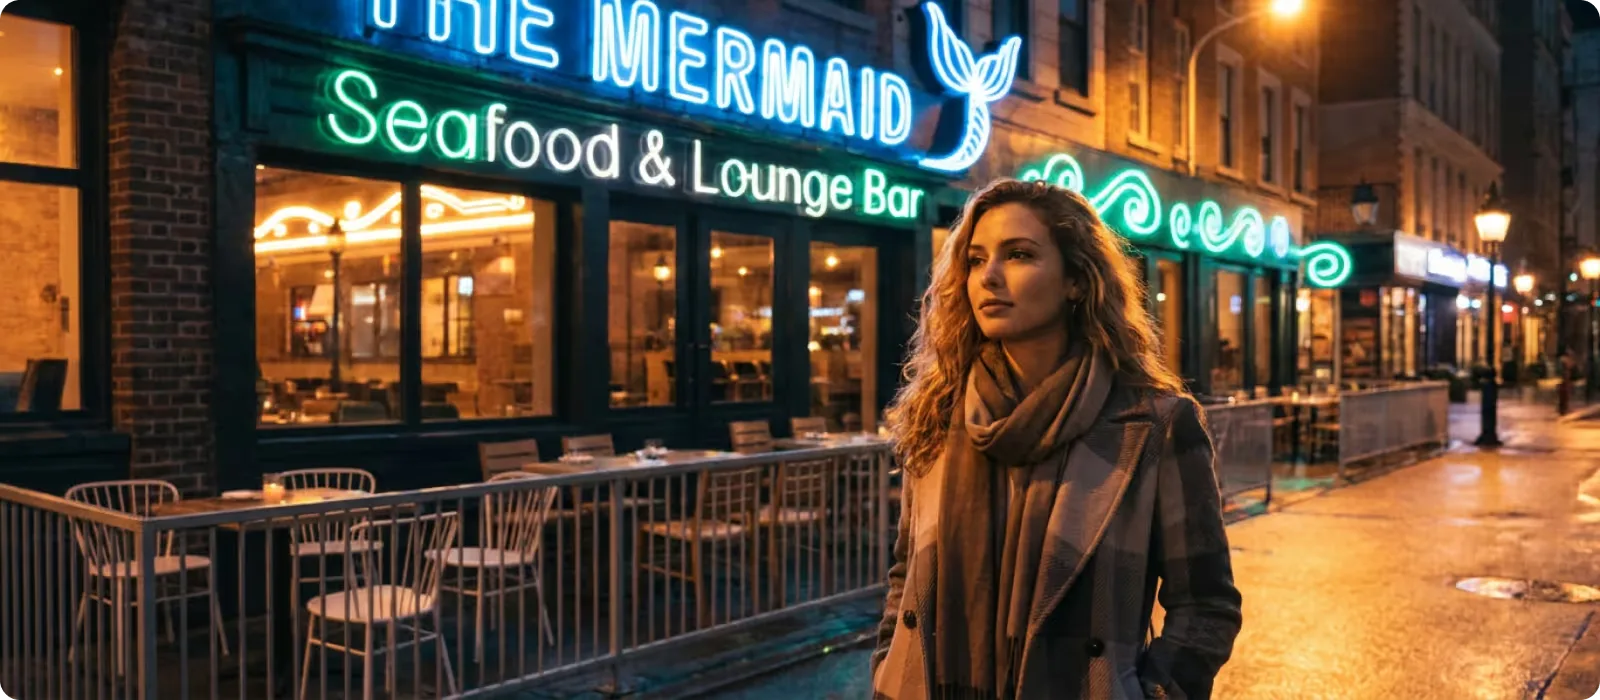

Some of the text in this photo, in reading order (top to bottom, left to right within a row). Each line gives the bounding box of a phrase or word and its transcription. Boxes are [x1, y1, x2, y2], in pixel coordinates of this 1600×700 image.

[327, 69, 924, 220] Seafood & Lounge Bar
[373, 0, 913, 145] HE MERMAID
